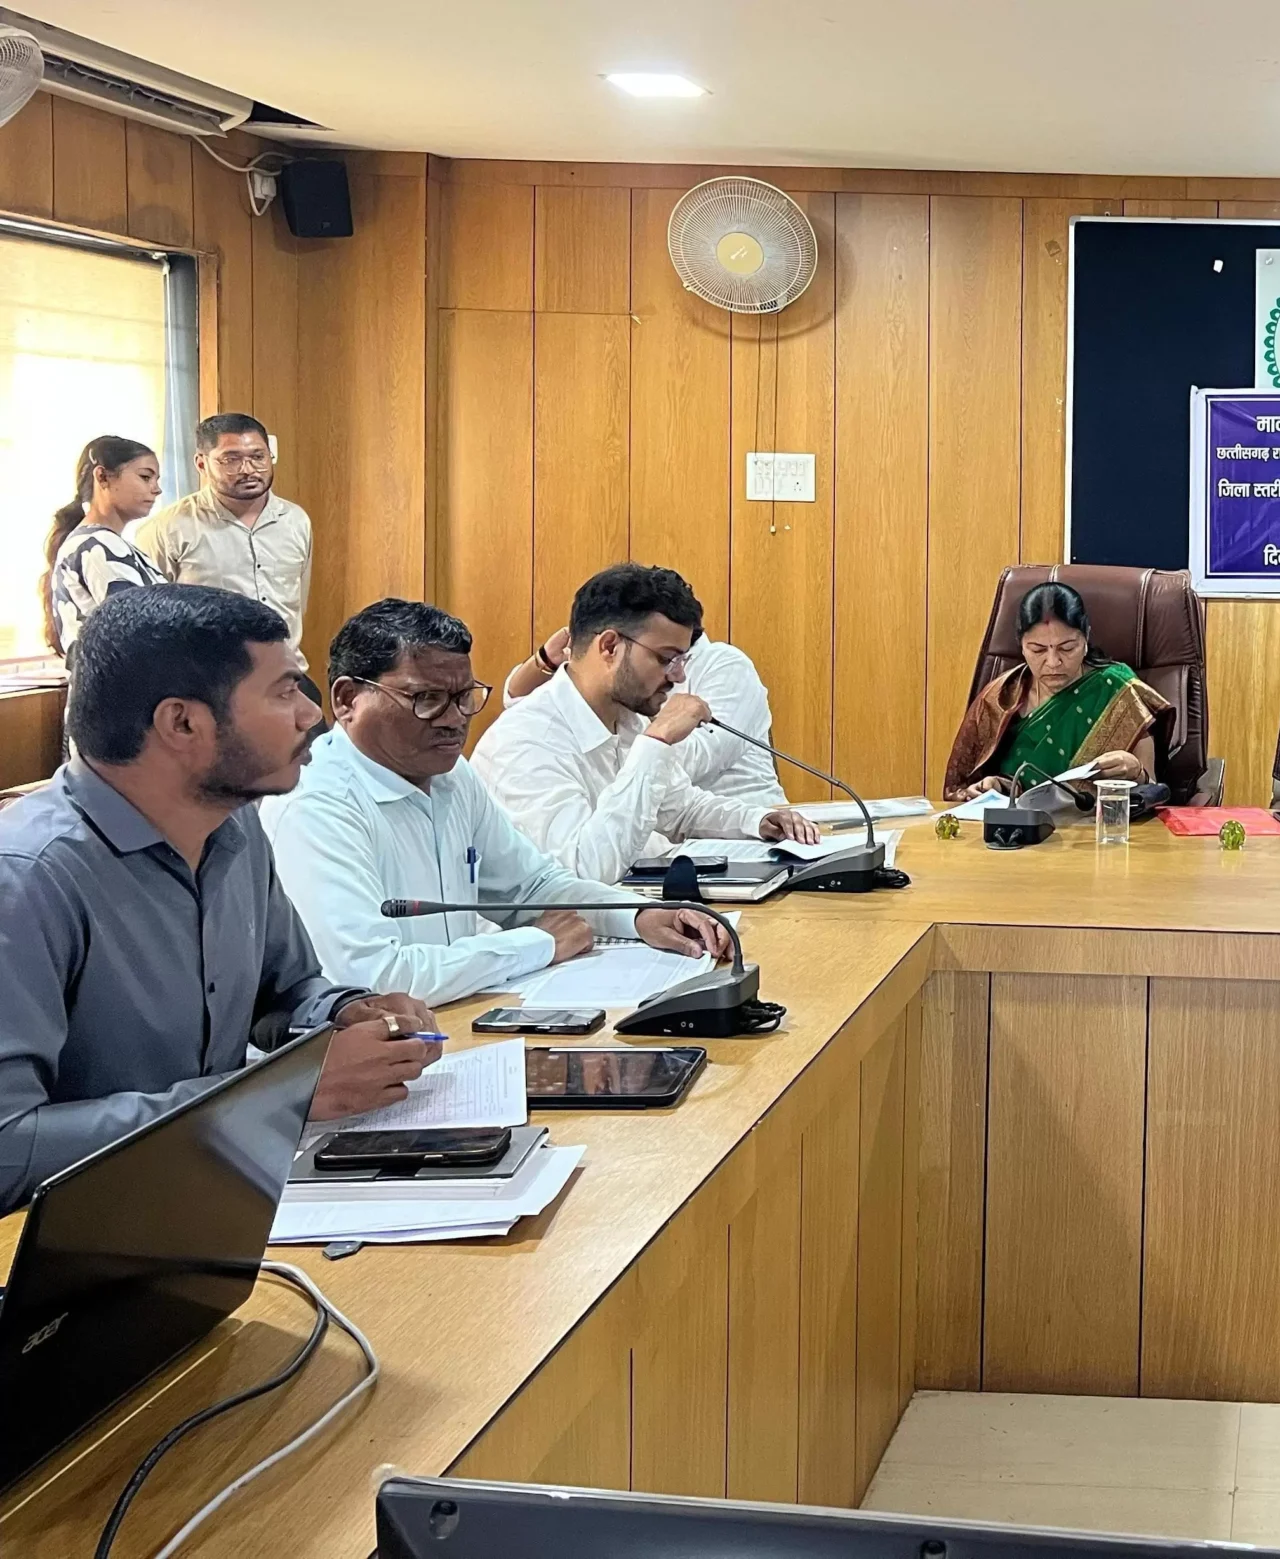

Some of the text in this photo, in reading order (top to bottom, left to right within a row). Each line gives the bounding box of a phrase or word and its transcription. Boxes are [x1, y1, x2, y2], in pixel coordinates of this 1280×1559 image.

[1216, 443, 1270, 462] छत्तीसगढ़
[1218, 478, 1251, 498] जिला
[22, 1311, 69, 1354] acer
